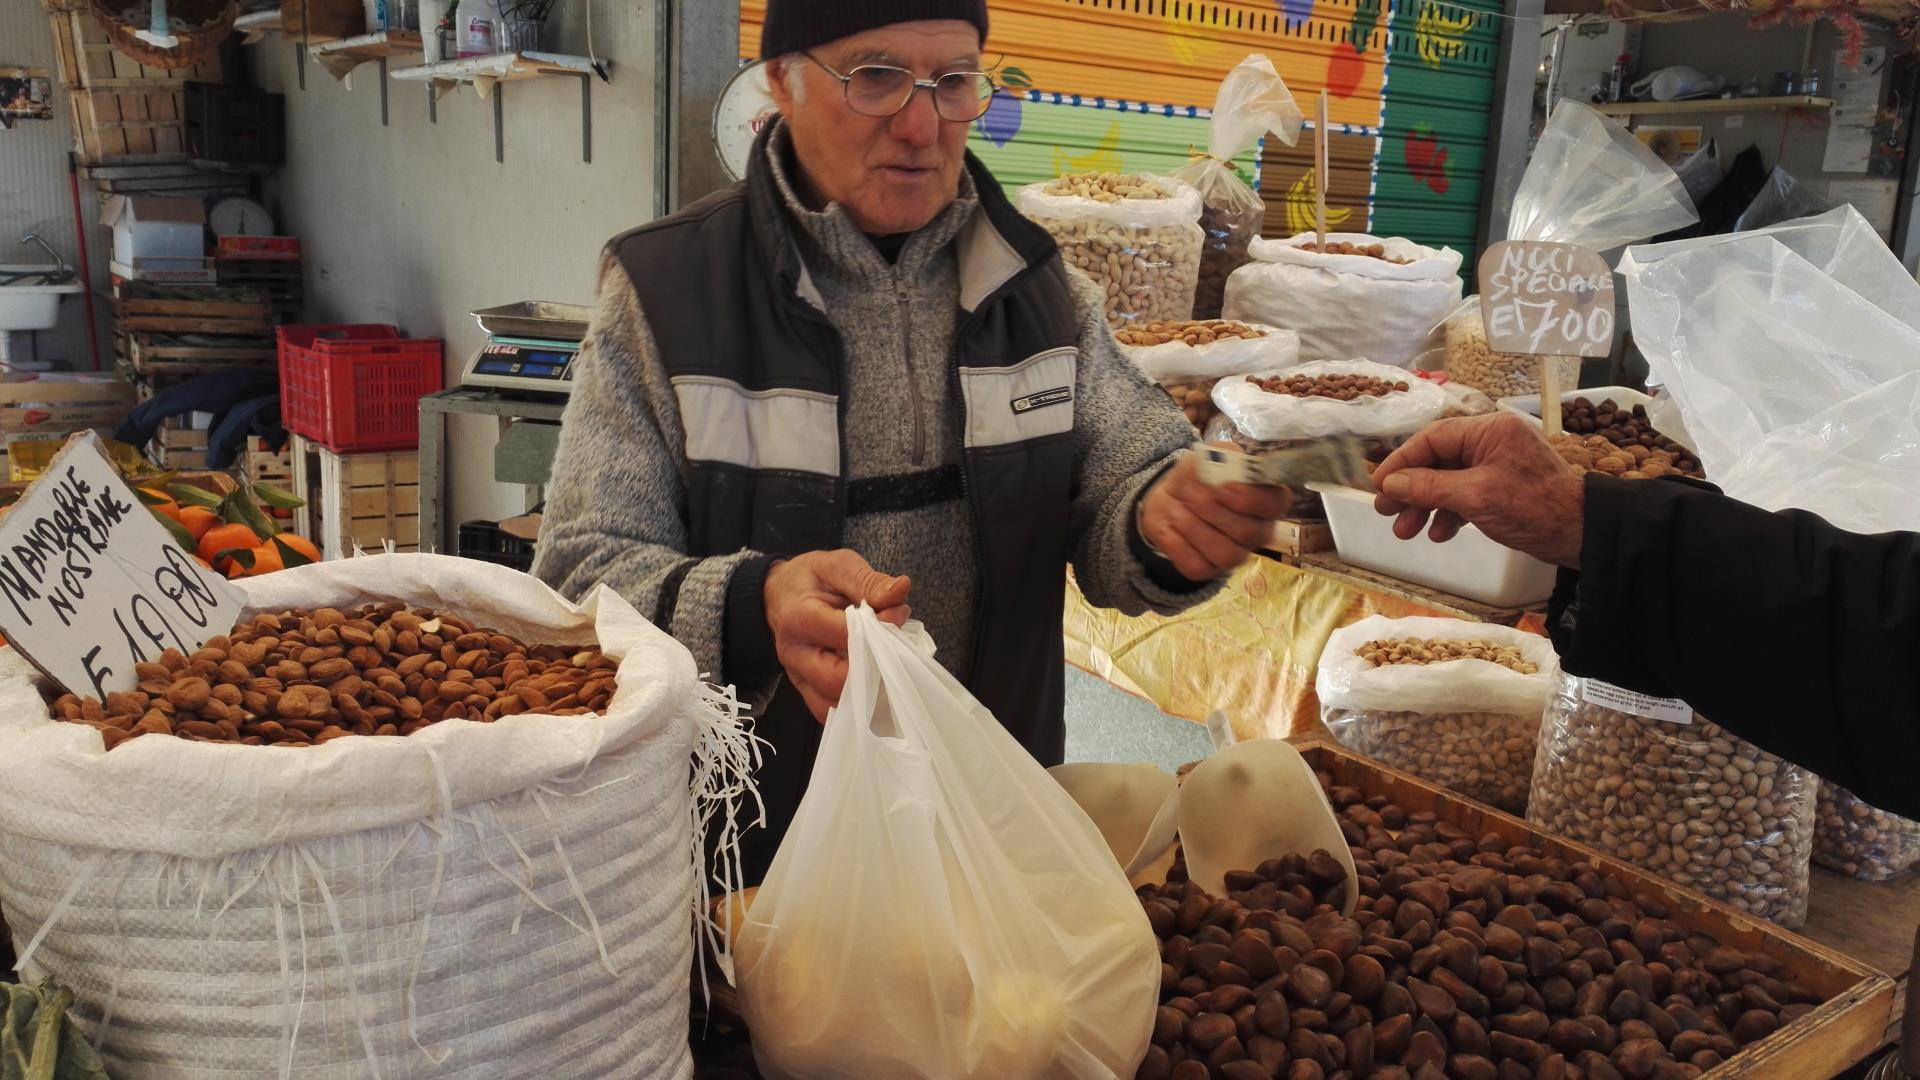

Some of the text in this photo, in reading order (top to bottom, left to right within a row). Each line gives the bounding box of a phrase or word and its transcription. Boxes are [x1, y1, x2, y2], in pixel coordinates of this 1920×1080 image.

[1500, 245, 1576, 275] NOCI
[0, 465, 91, 627] MANDORLE
[47, 485, 133, 627] NOSTRANE
